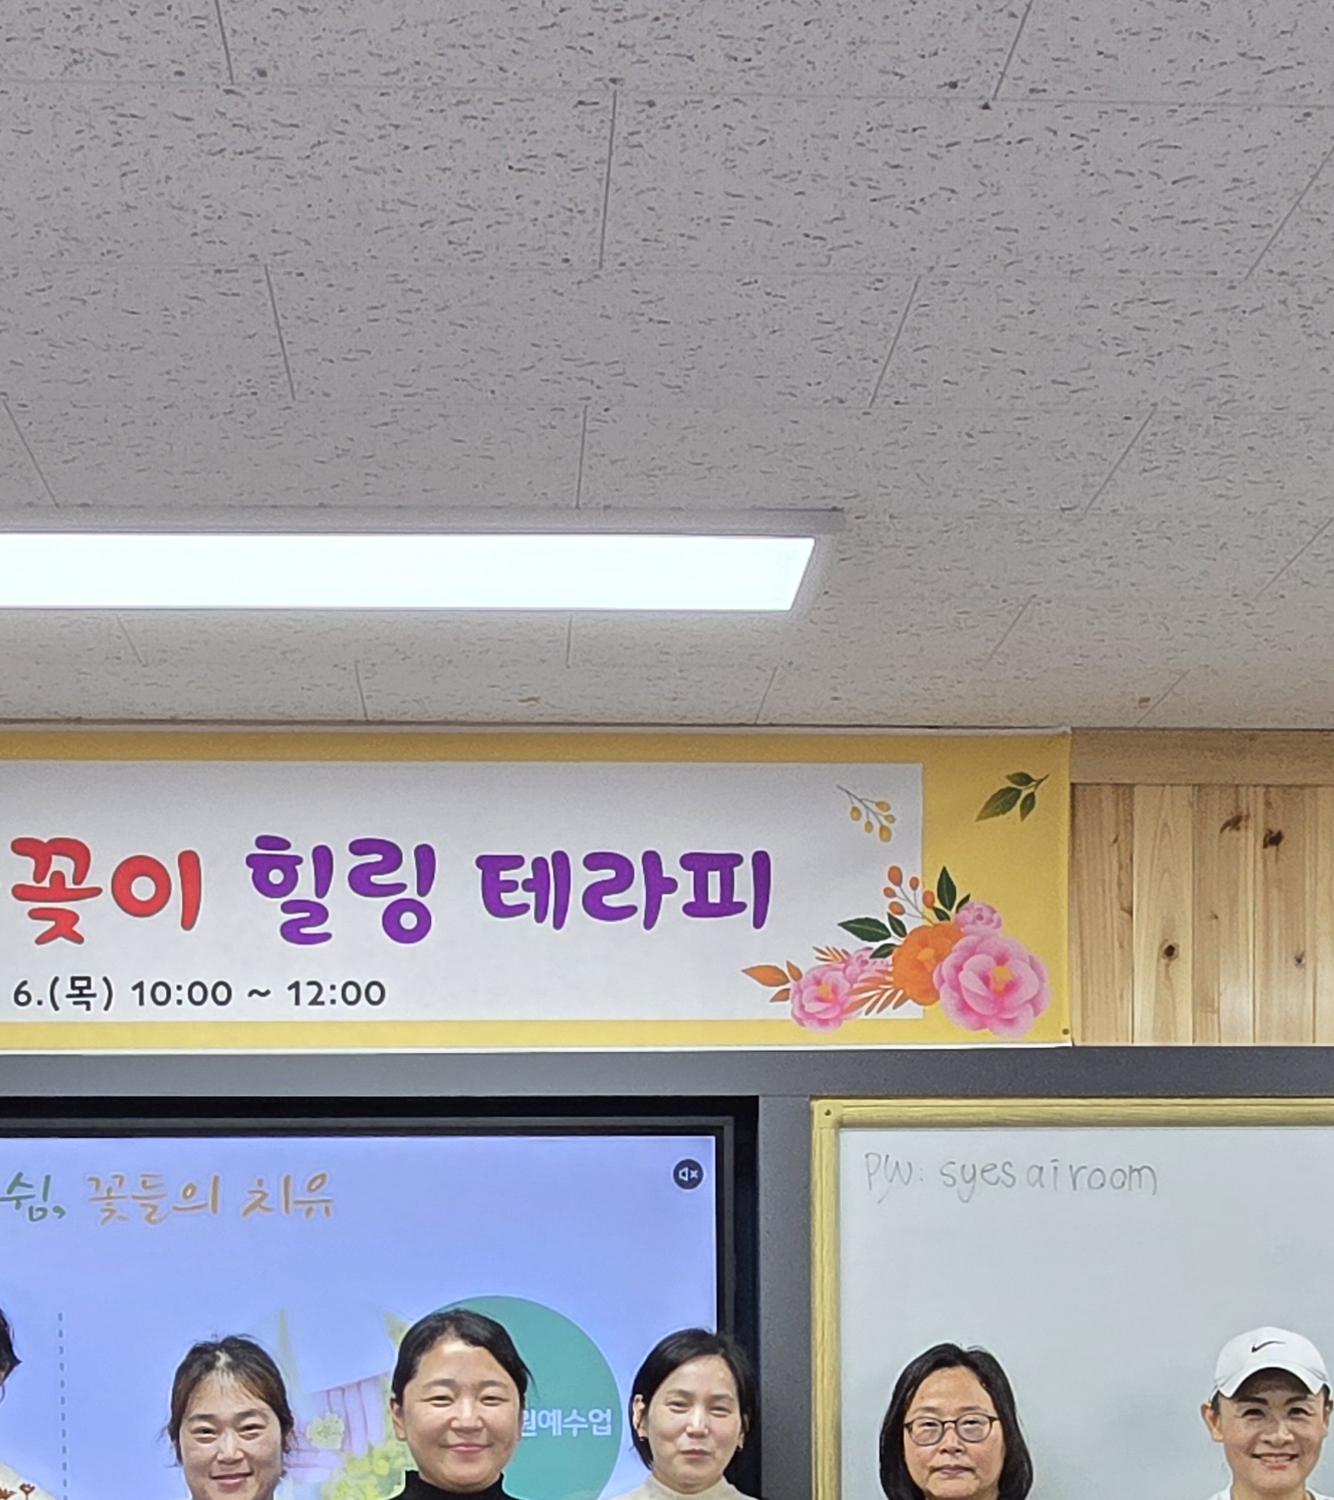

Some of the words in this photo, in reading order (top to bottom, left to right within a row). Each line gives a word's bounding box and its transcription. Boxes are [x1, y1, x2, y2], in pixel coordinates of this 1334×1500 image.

[245, 834, 436, 945] 힐링
[475, 849, 771, 930] 테라피
[13, 976, 114, 1011] 6.(목)
[131, 980, 232, 1006] 10:00
[287, 980, 386, 1006] 12:00
[87, 1173, 221, 1226] 꽃들의
[240, 1172, 335, 1218] 치유
